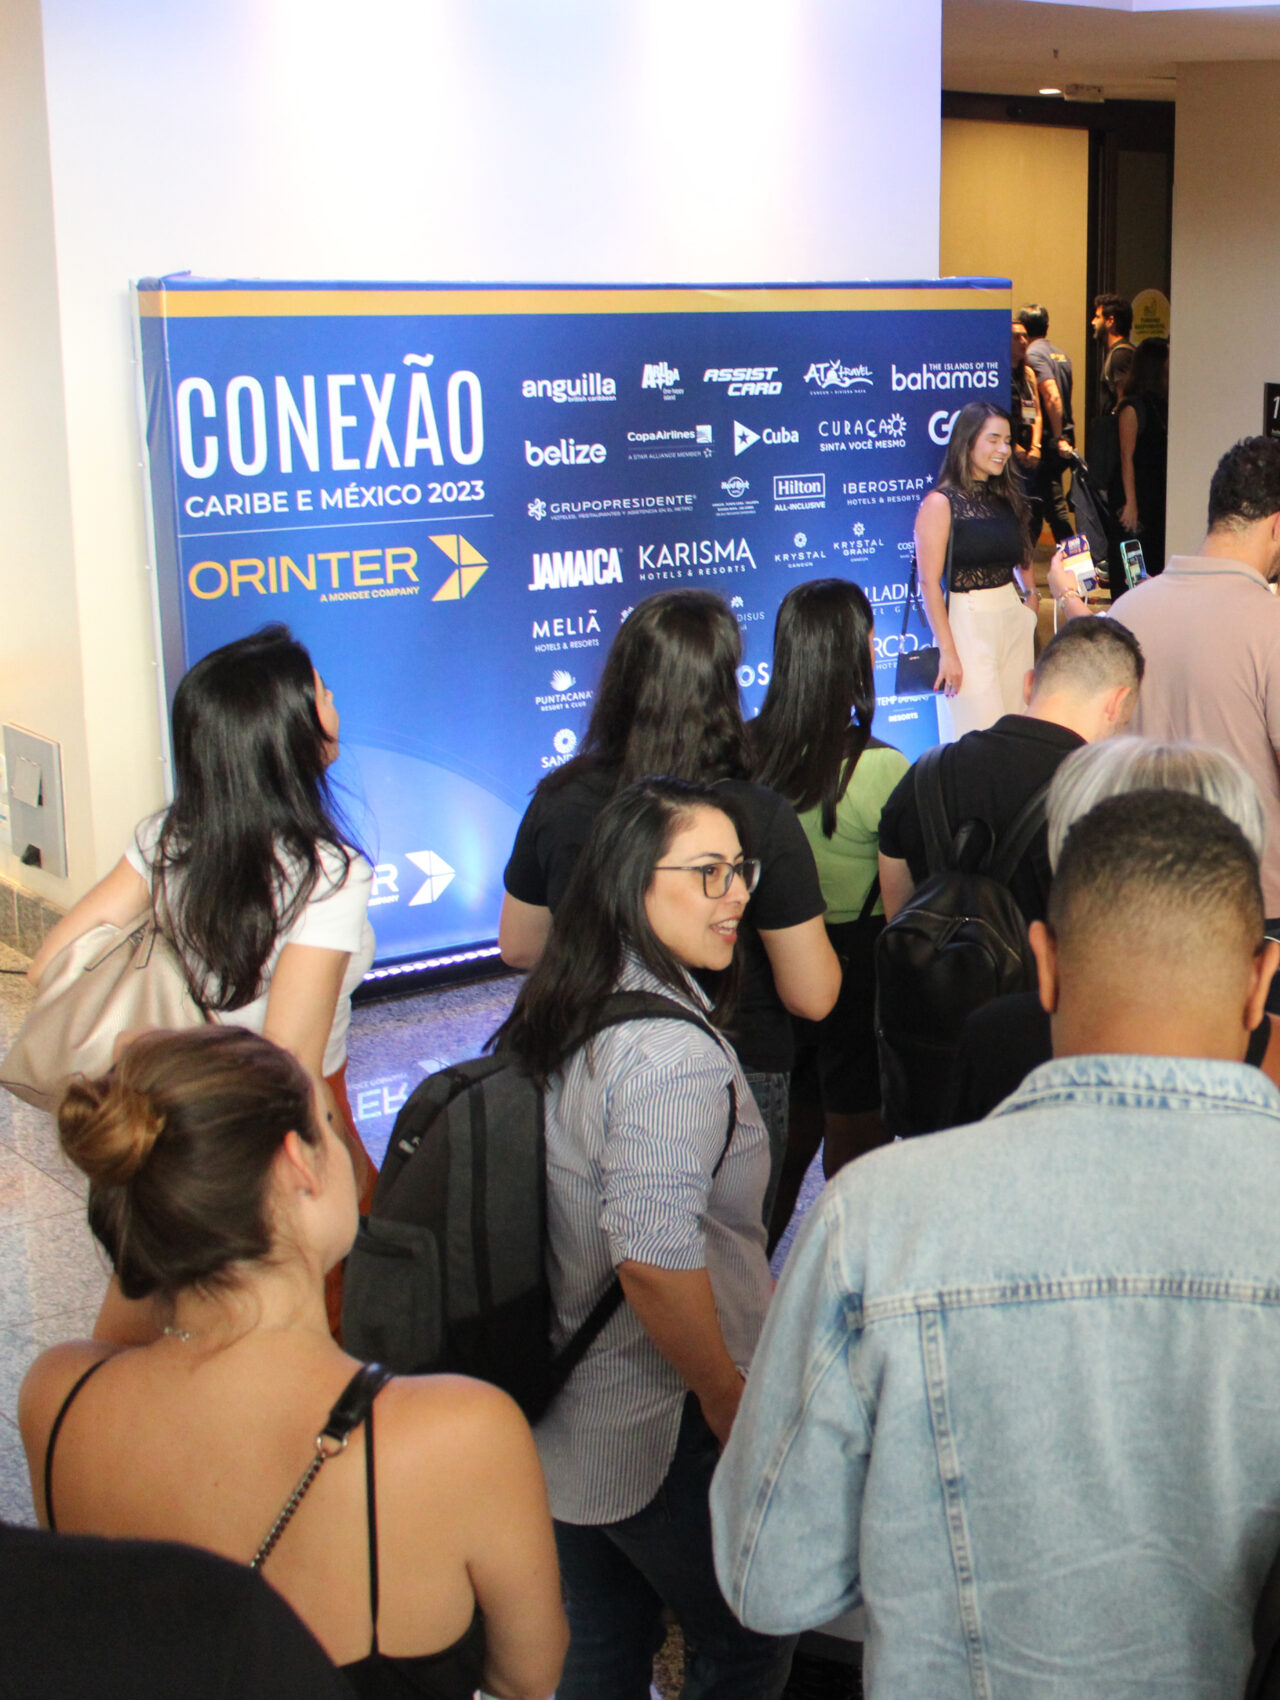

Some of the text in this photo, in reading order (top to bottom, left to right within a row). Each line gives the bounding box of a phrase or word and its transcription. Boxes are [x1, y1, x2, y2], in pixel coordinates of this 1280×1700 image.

[929, 362, 998, 371] THE ISLANDS OF THE
[703, 367, 778, 382] ASSIST
[891, 364, 999, 391] bahamas
[522, 372, 616, 403] anguilla
[727, 381, 782, 396] CARD
[176, 353, 485, 479] CONEXÃO
[762, 426, 799, 444] Cuba
[524, 438, 607, 467] belize
[820, 439, 906, 452] SINTA VOCÊ MESMO
[778, 480, 821, 495] Hilton
[843, 478, 924, 494] IBEROSTAR
[185, 480, 485, 518] CARIBE E MÉXICO 2023
[550, 494, 694, 514] GRUPOPRESIDENTE
[774, 501, 826, 511] ALL-INCLUSIVE
[847, 497, 876, 506] HOTELS
[887, 494, 920, 503] RESORTS
[833, 539, 884, 550] KRYSTAL
[843, 547, 876, 556] GRAND
[897, 541, 915, 551] COST
[638, 537, 757, 570] KARISMA
[774, 551, 826, 562] KRYSTAL
[188, 546, 420, 600] ORINTER
[528, 547, 623, 591] JAMAICA
[640, 565, 746, 581] HOTELS & RESORTS
[320, 586, 420, 602] A MONDEE COMPANY
[736, 611, 765, 622] DISUS
[535, 642, 561, 652] HOTELS
[570, 639, 599, 649] RESORTS
[876, 662, 898, 670] HOTE
[535, 691, 591, 705] PUNTACANA
[540, 703, 564, 712] RESORT
[571, 701, 586, 709] CLUB
